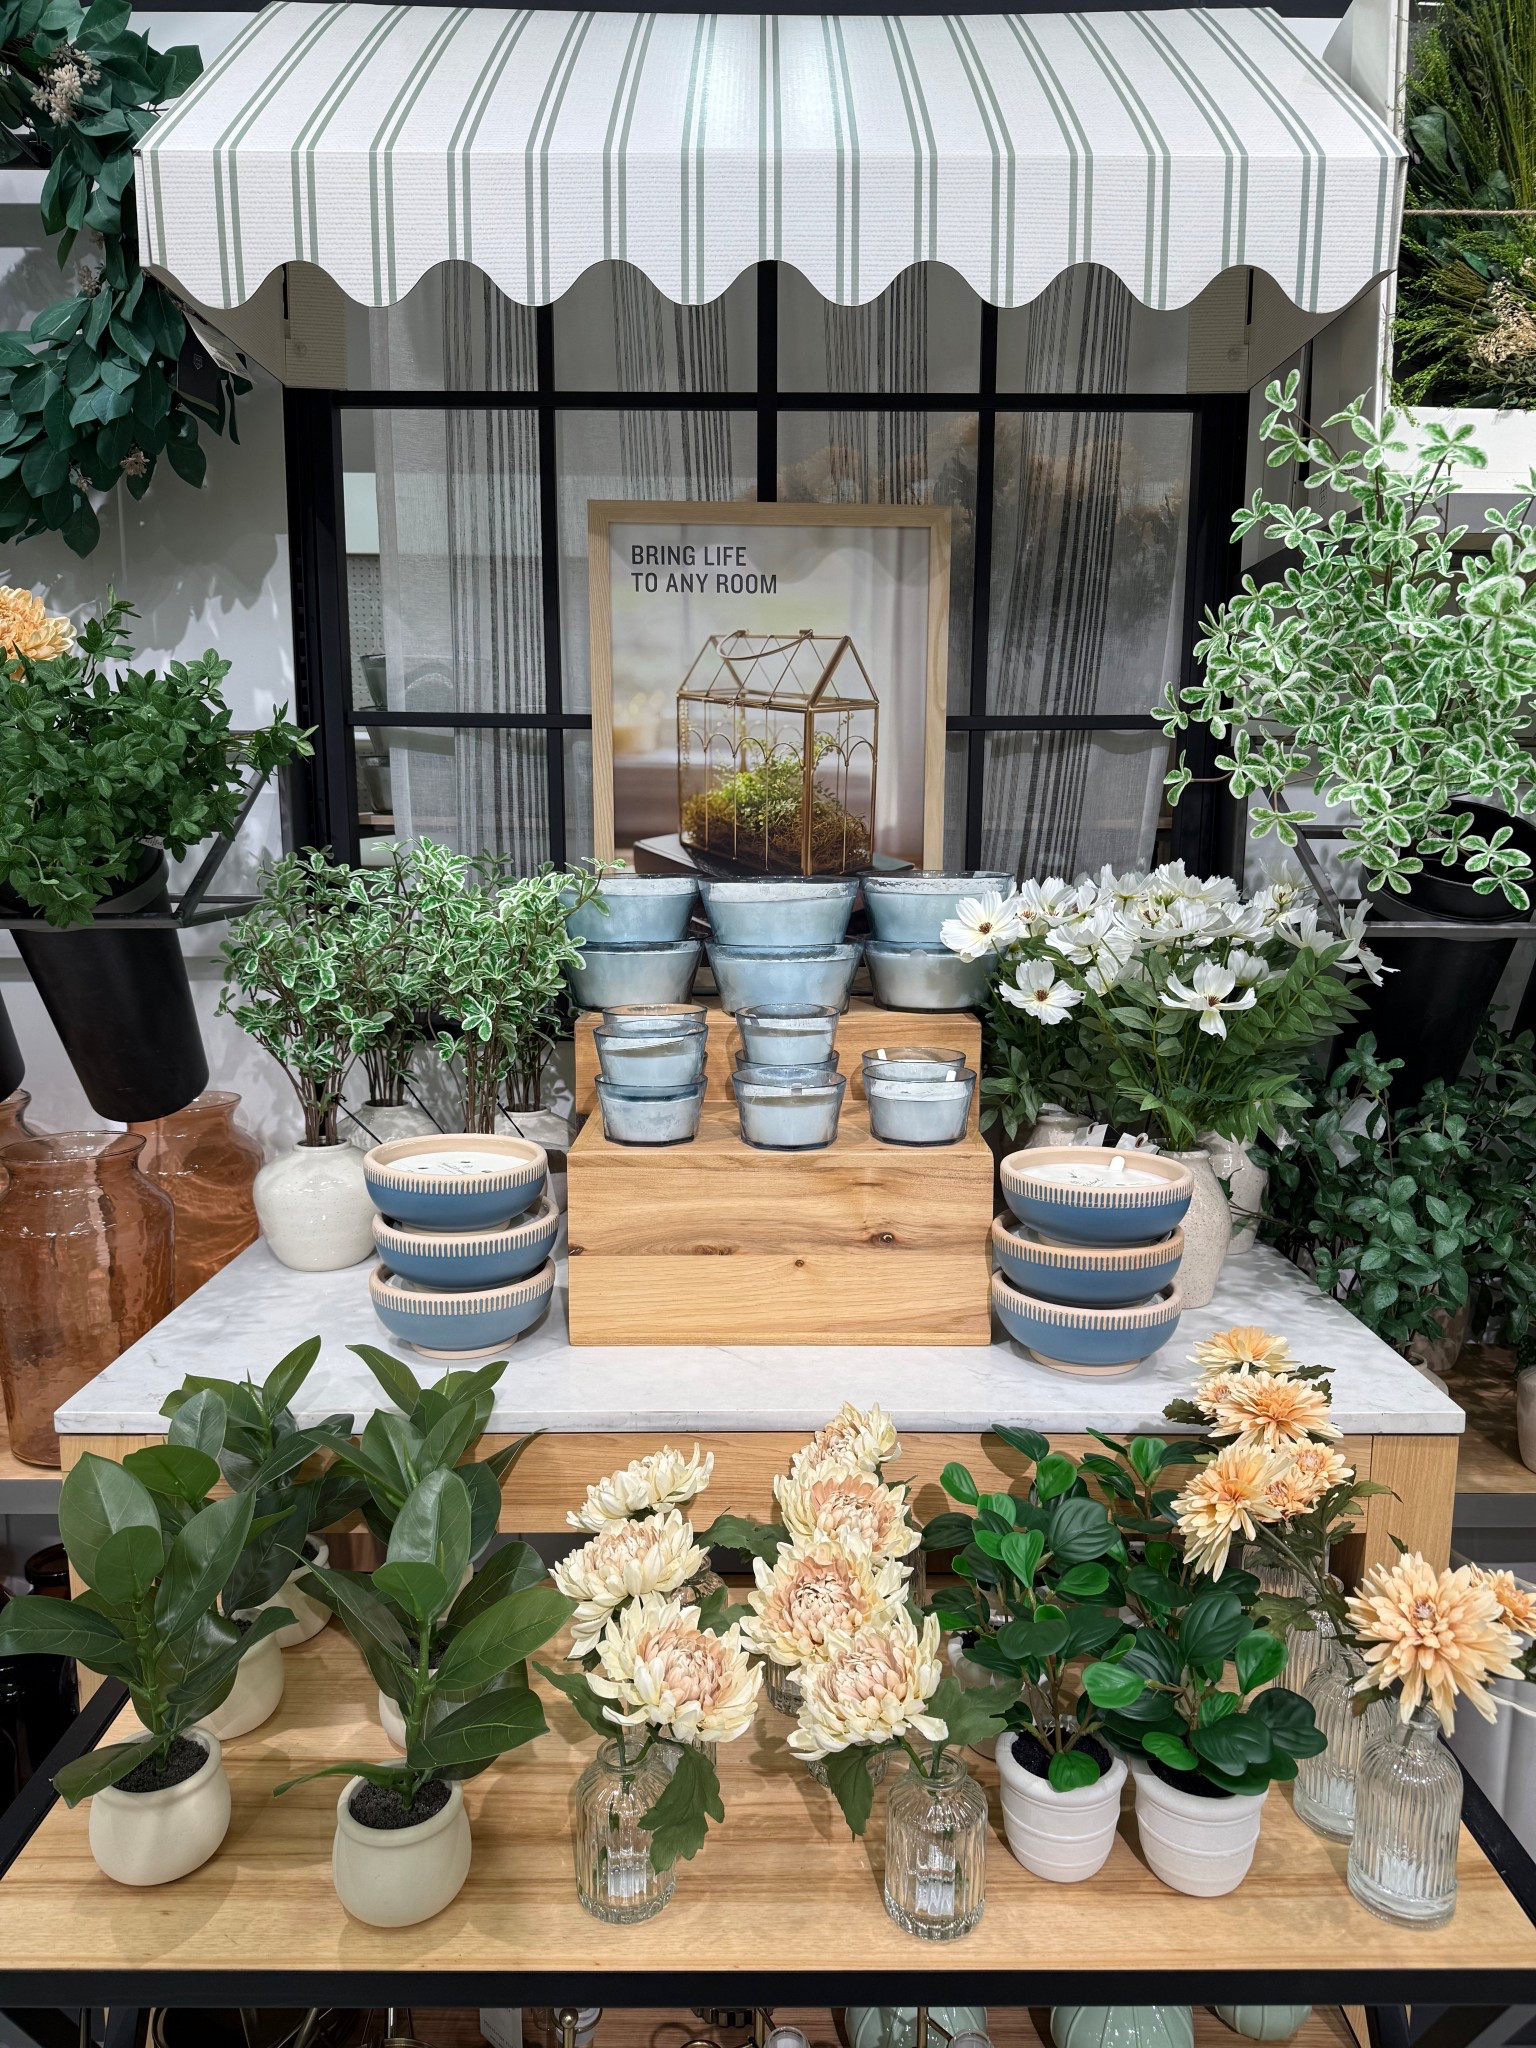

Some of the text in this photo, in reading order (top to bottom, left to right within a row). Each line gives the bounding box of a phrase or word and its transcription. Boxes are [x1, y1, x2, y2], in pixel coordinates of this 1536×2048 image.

[631, 545, 747, 567] BRING LIFE
[631, 572, 777, 594] TO ANY ROOM
